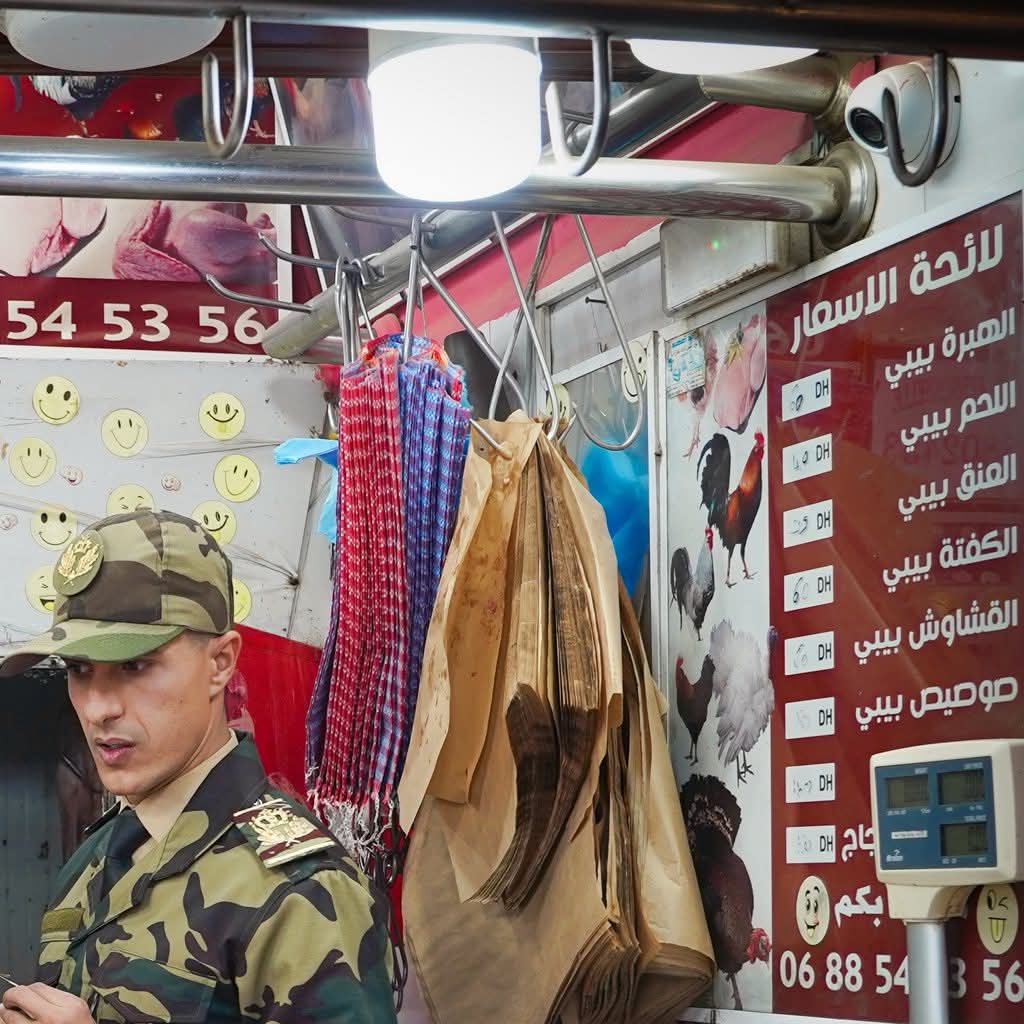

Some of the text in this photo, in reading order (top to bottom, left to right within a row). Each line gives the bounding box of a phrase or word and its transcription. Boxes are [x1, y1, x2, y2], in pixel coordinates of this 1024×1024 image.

[909, 224, 1003, 296] لائحة
[7, 301, 76, 341] 54
[103, 303, 171, 343] 53
[198, 306, 265, 345] 56
[884, 307, 1015, 390] الهبرة بيبي
[815, 377, 830, 399] DH
[900, 380, 1016, 453] اللحم بيبي
[815, 441, 831, 462] DH
[898, 453, 1017, 522] العنق بيبي
[816, 510, 831, 530] DH
[882, 526, 1018, 593] الكفتة بيبي
[817, 575, 832, 594] DH
[817, 642, 833, 661] DH
[854, 599, 1019, 665] القشاوش بيبي
[818, 708, 833, 727] DH
[855, 694, 904, 731] بيبي
[910, 676, 1019, 719] صوصيص
[818, 773, 833, 792] DH
[819, 835, 834, 852] DH
[834, 885, 884, 928] بكم
[779, 950, 816, 989] 06
[825, 952, 864, 992] 88
[875, 954, 909, 995] 54
[981, 959, 1024, 1003] 56
